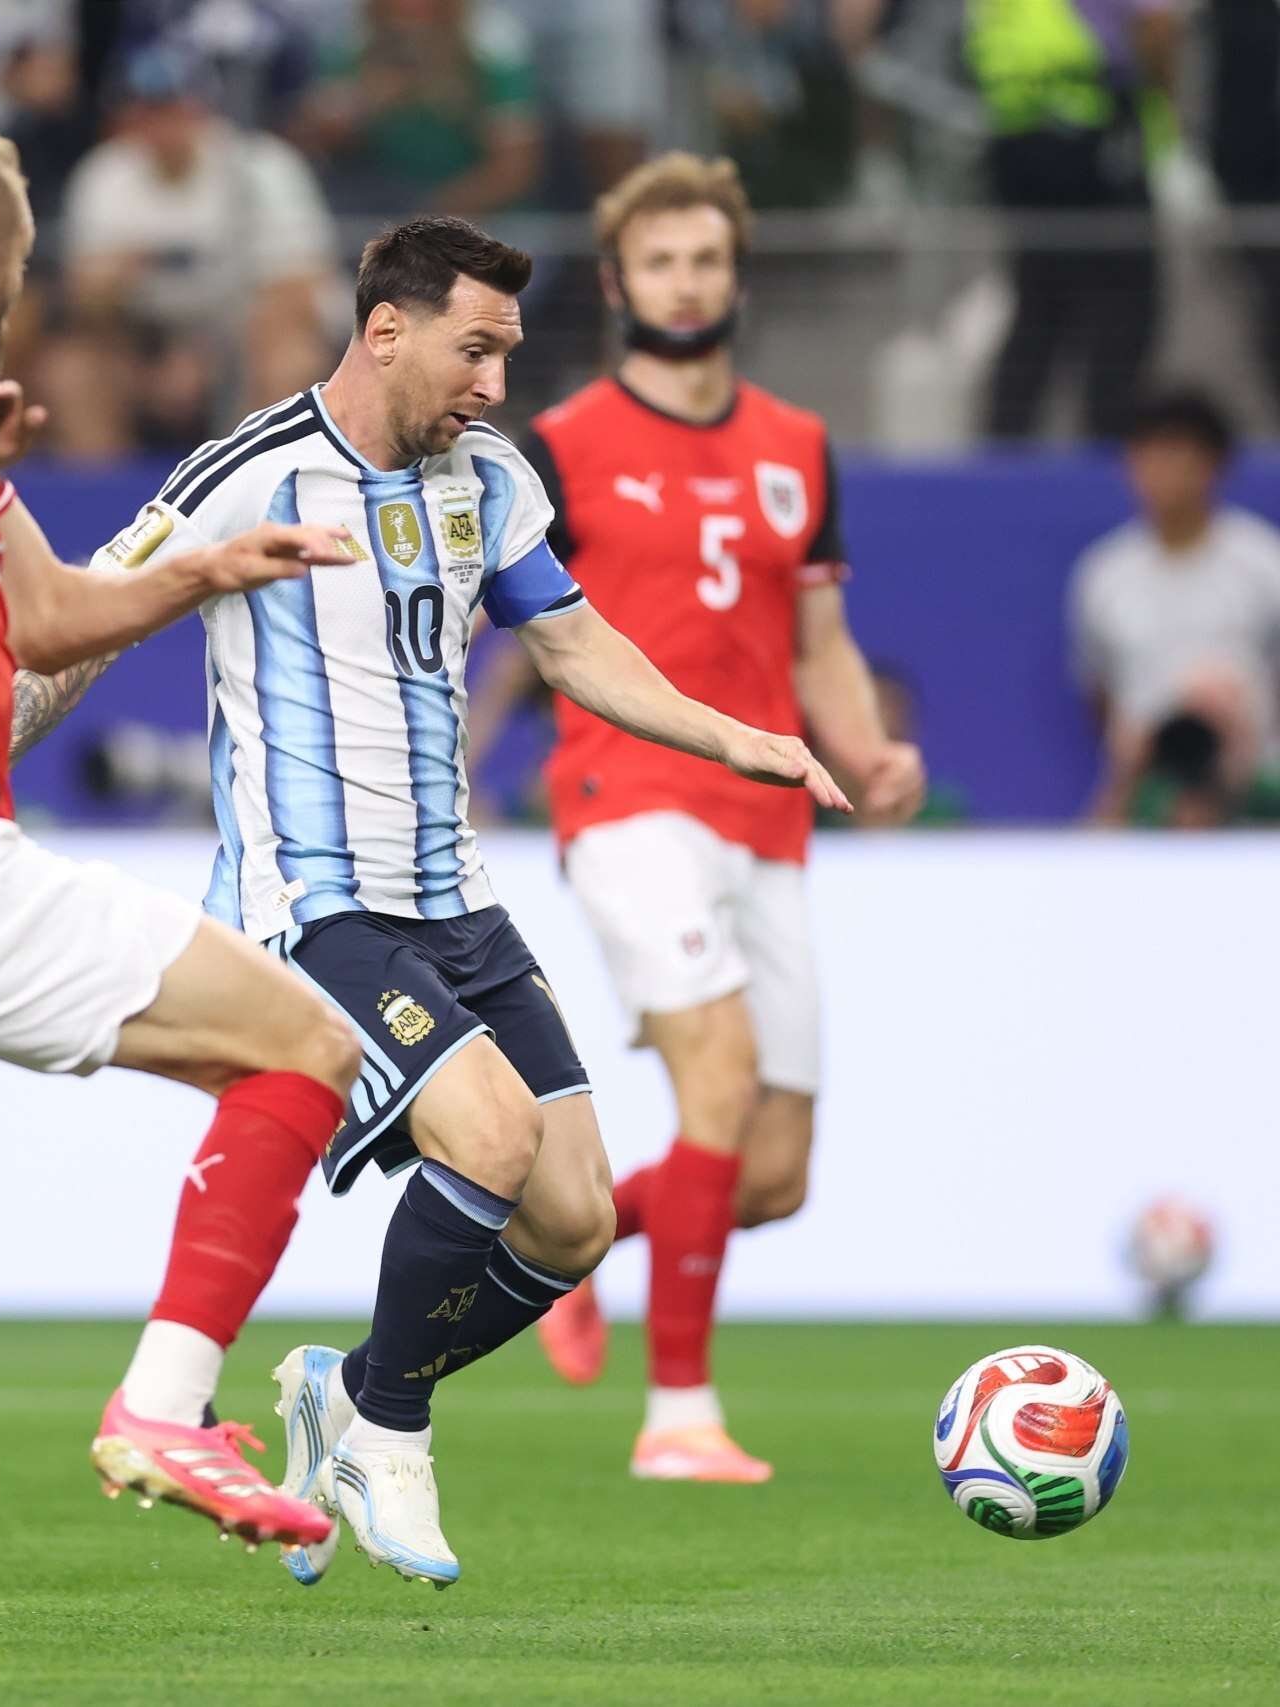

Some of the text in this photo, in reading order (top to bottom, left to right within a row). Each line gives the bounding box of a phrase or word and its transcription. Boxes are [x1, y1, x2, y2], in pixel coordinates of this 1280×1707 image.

[450, 513, 475, 541] AFA
[393, 542, 414, 552] FIFA
[696, 513, 746, 613] 5
[384, 584, 445, 677] 10
[394, 1007, 422, 1032] AFA
